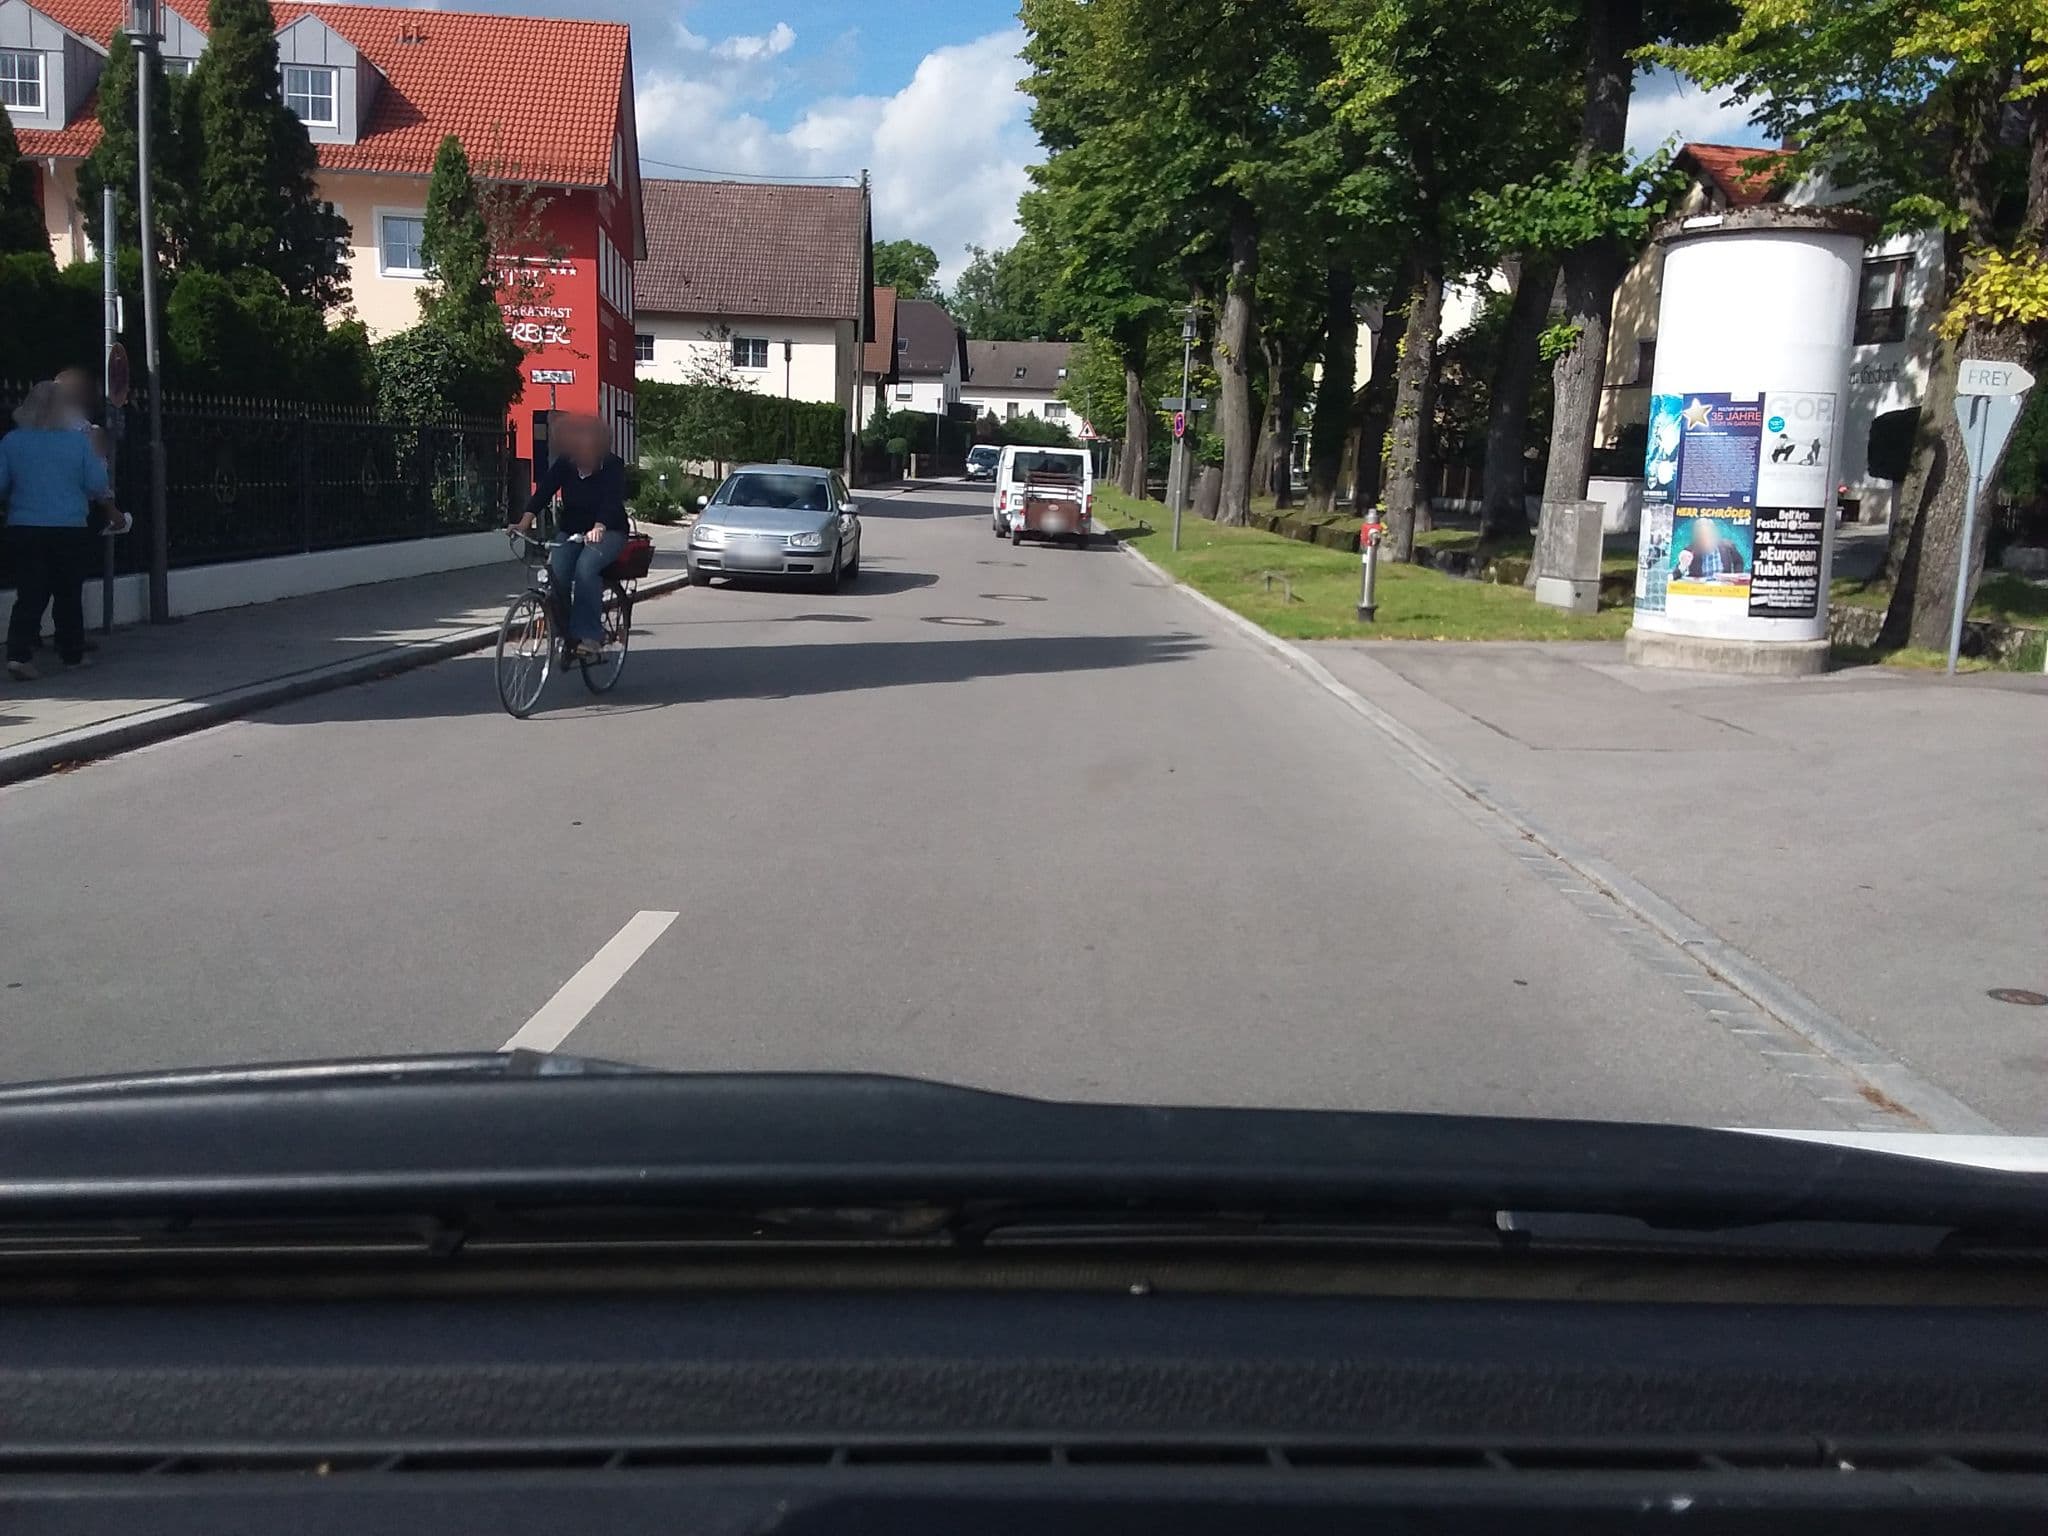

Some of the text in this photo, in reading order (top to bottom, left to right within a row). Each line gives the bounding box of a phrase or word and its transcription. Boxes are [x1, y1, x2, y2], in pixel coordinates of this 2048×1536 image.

[1968, 370, 2012, 386] FREY
[1711, 412, 1761, 421] 35 JAHRE
[1700, 506, 1752, 518] SCHRÖDER
[1757, 518, 1788, 529] Festival
[1754, 561, 1783, 576] Tuba
